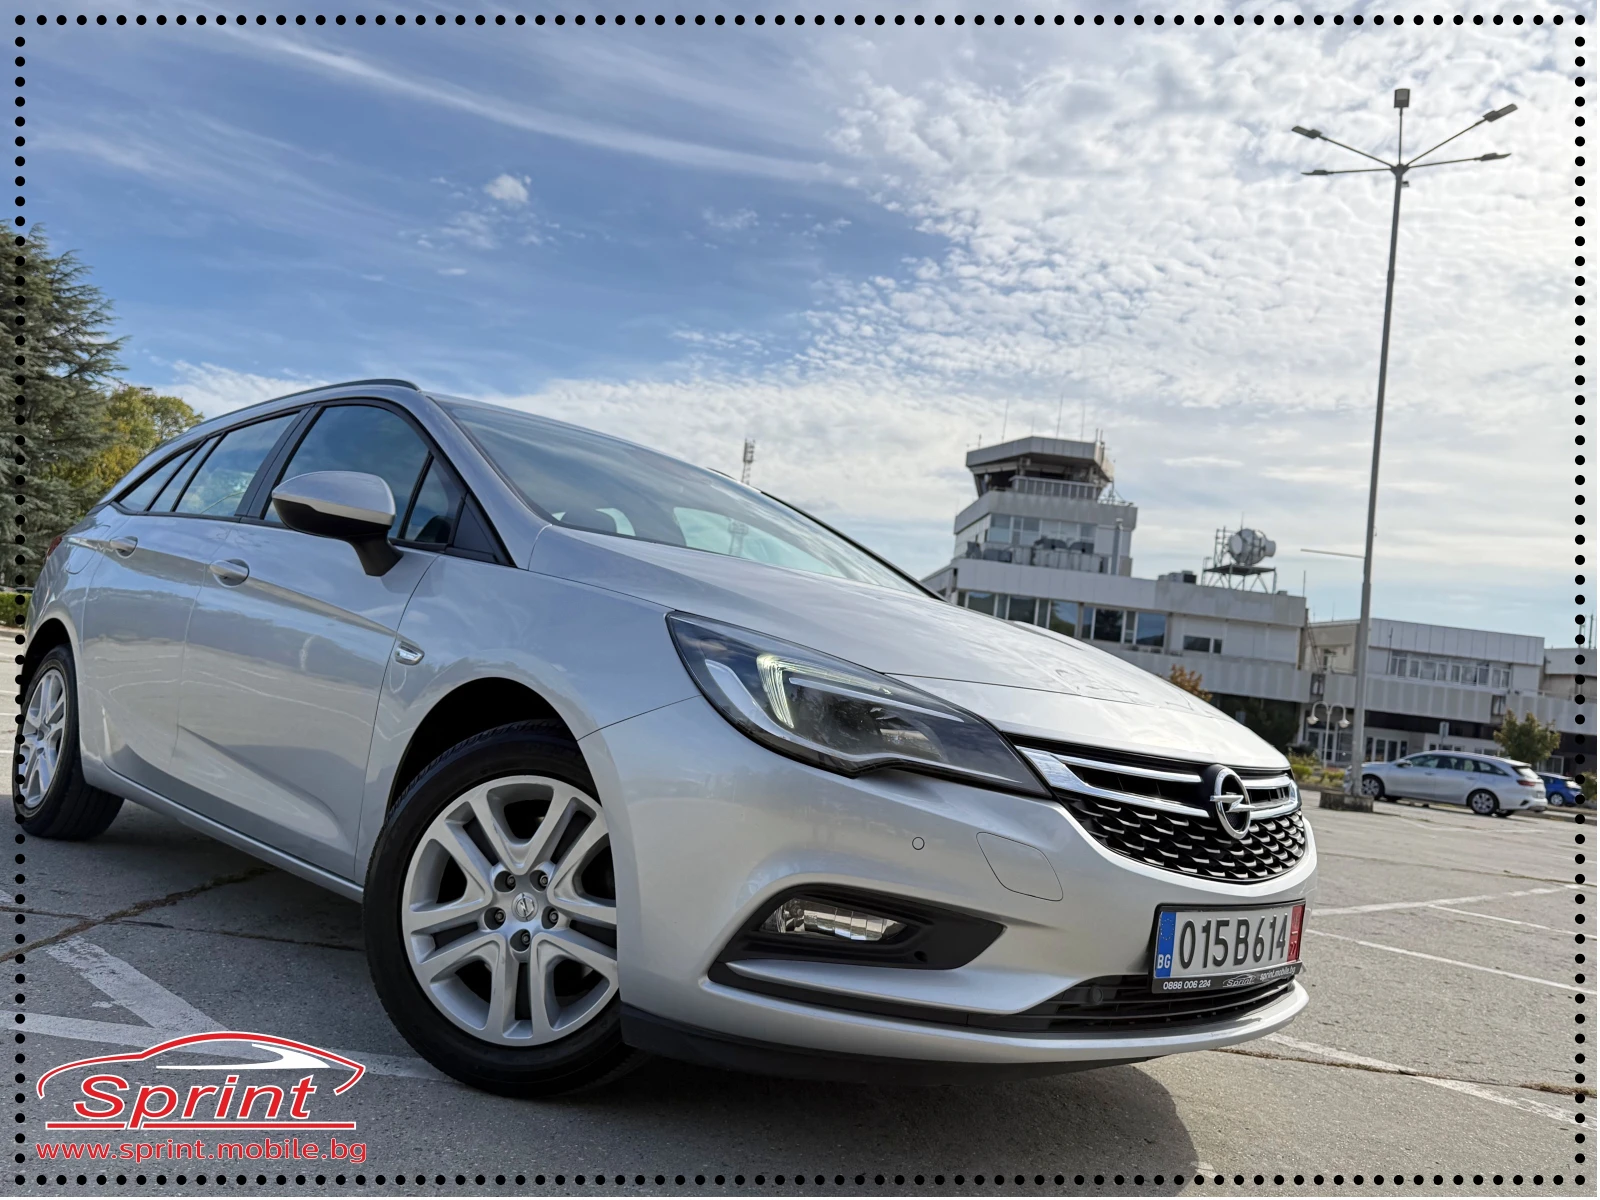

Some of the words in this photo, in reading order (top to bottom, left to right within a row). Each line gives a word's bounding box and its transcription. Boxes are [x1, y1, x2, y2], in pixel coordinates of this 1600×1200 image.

[1179, 913, 1288, 969] 015B614
[1157, 954, 1171, 969] BG
[1259, 966, 1296, 981] sprint.mobile.bg
[1163, 981, 1182, 990] 0888
[1184, 981, 1198, 989] 006
[1199, 980, 1211, 988] 224
[1226, 976, 1254, 987] Sprint
